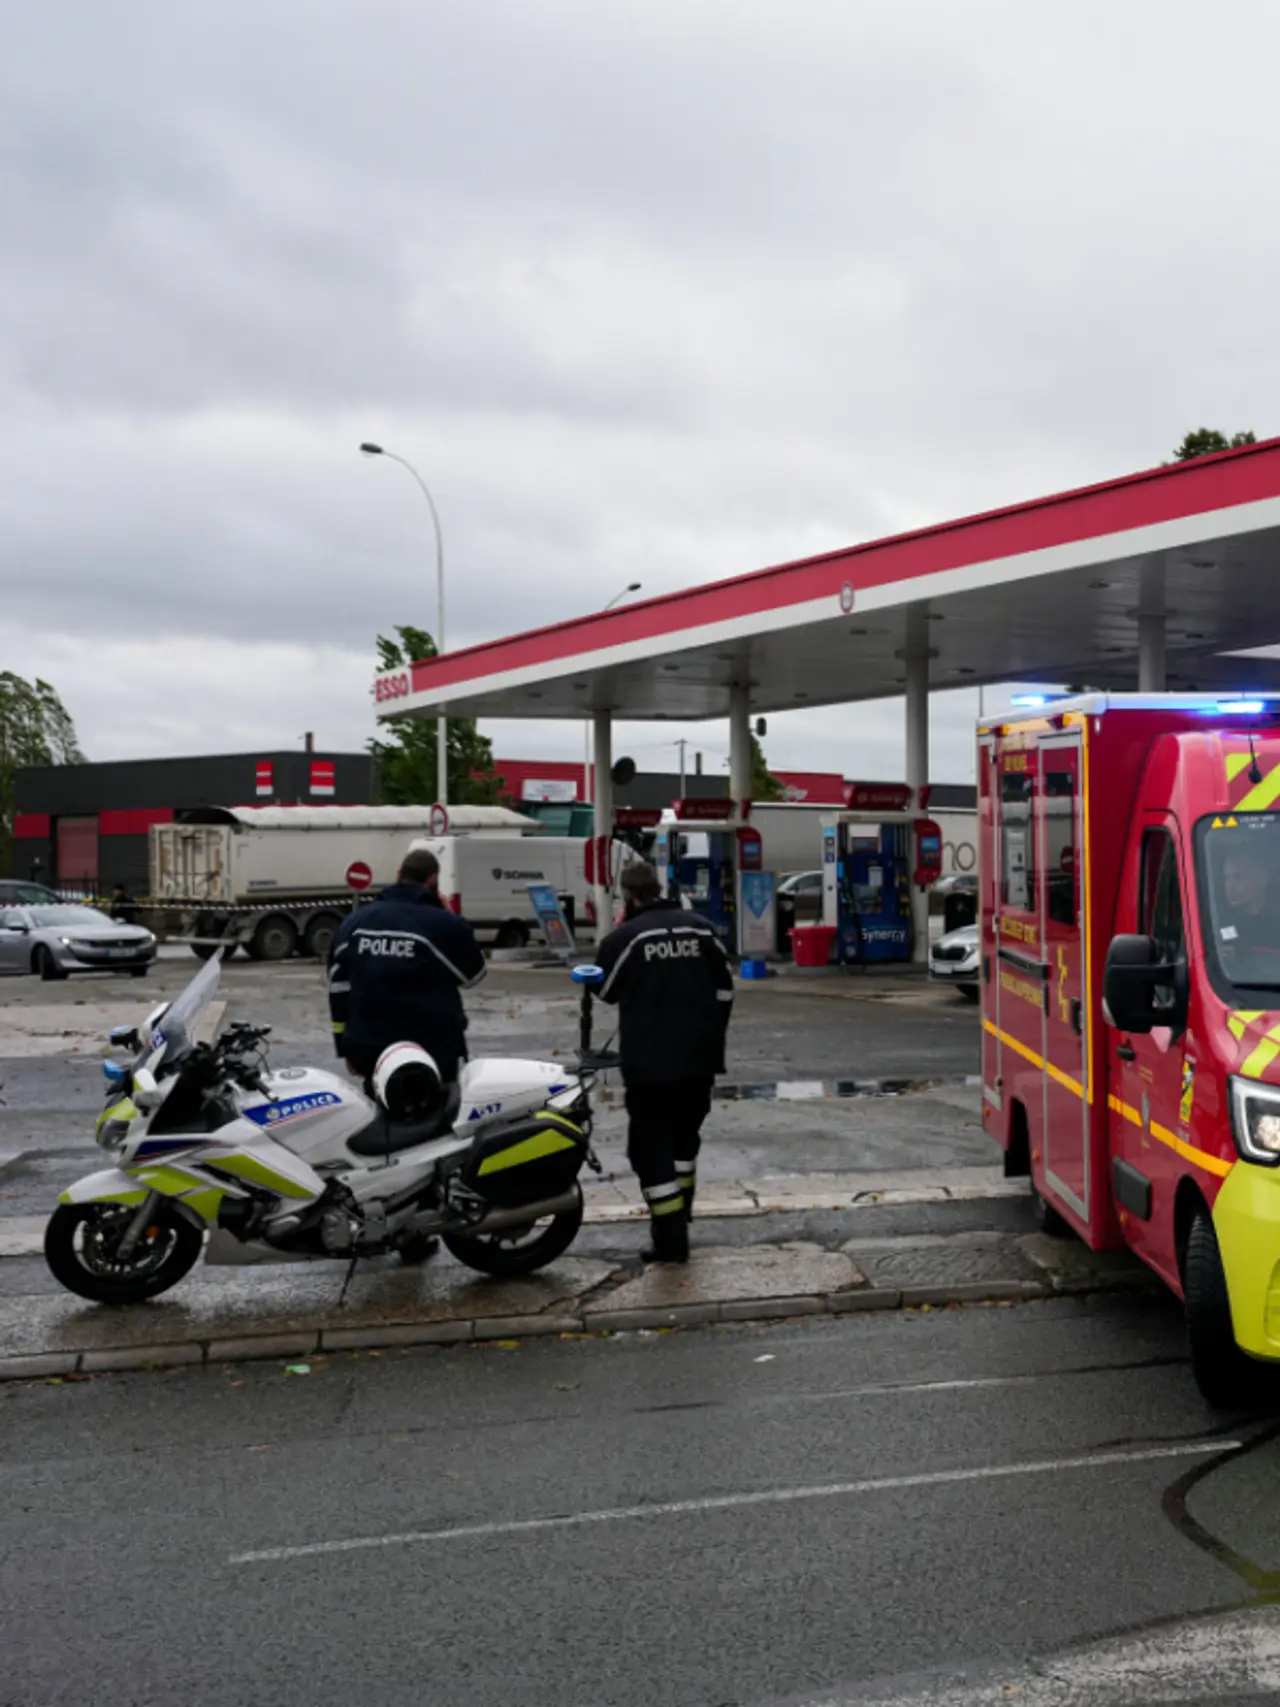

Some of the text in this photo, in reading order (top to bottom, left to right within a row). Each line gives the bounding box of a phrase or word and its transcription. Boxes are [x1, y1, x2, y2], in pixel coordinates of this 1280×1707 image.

[375, 672, 409, 703] ESSO
[861, 928, 906, 944] Synergy
[358, 937, 416, 958] POLICE
[643, 939, 701, 962] POLICE
[281, 1094, 335, 1116] POLICE
